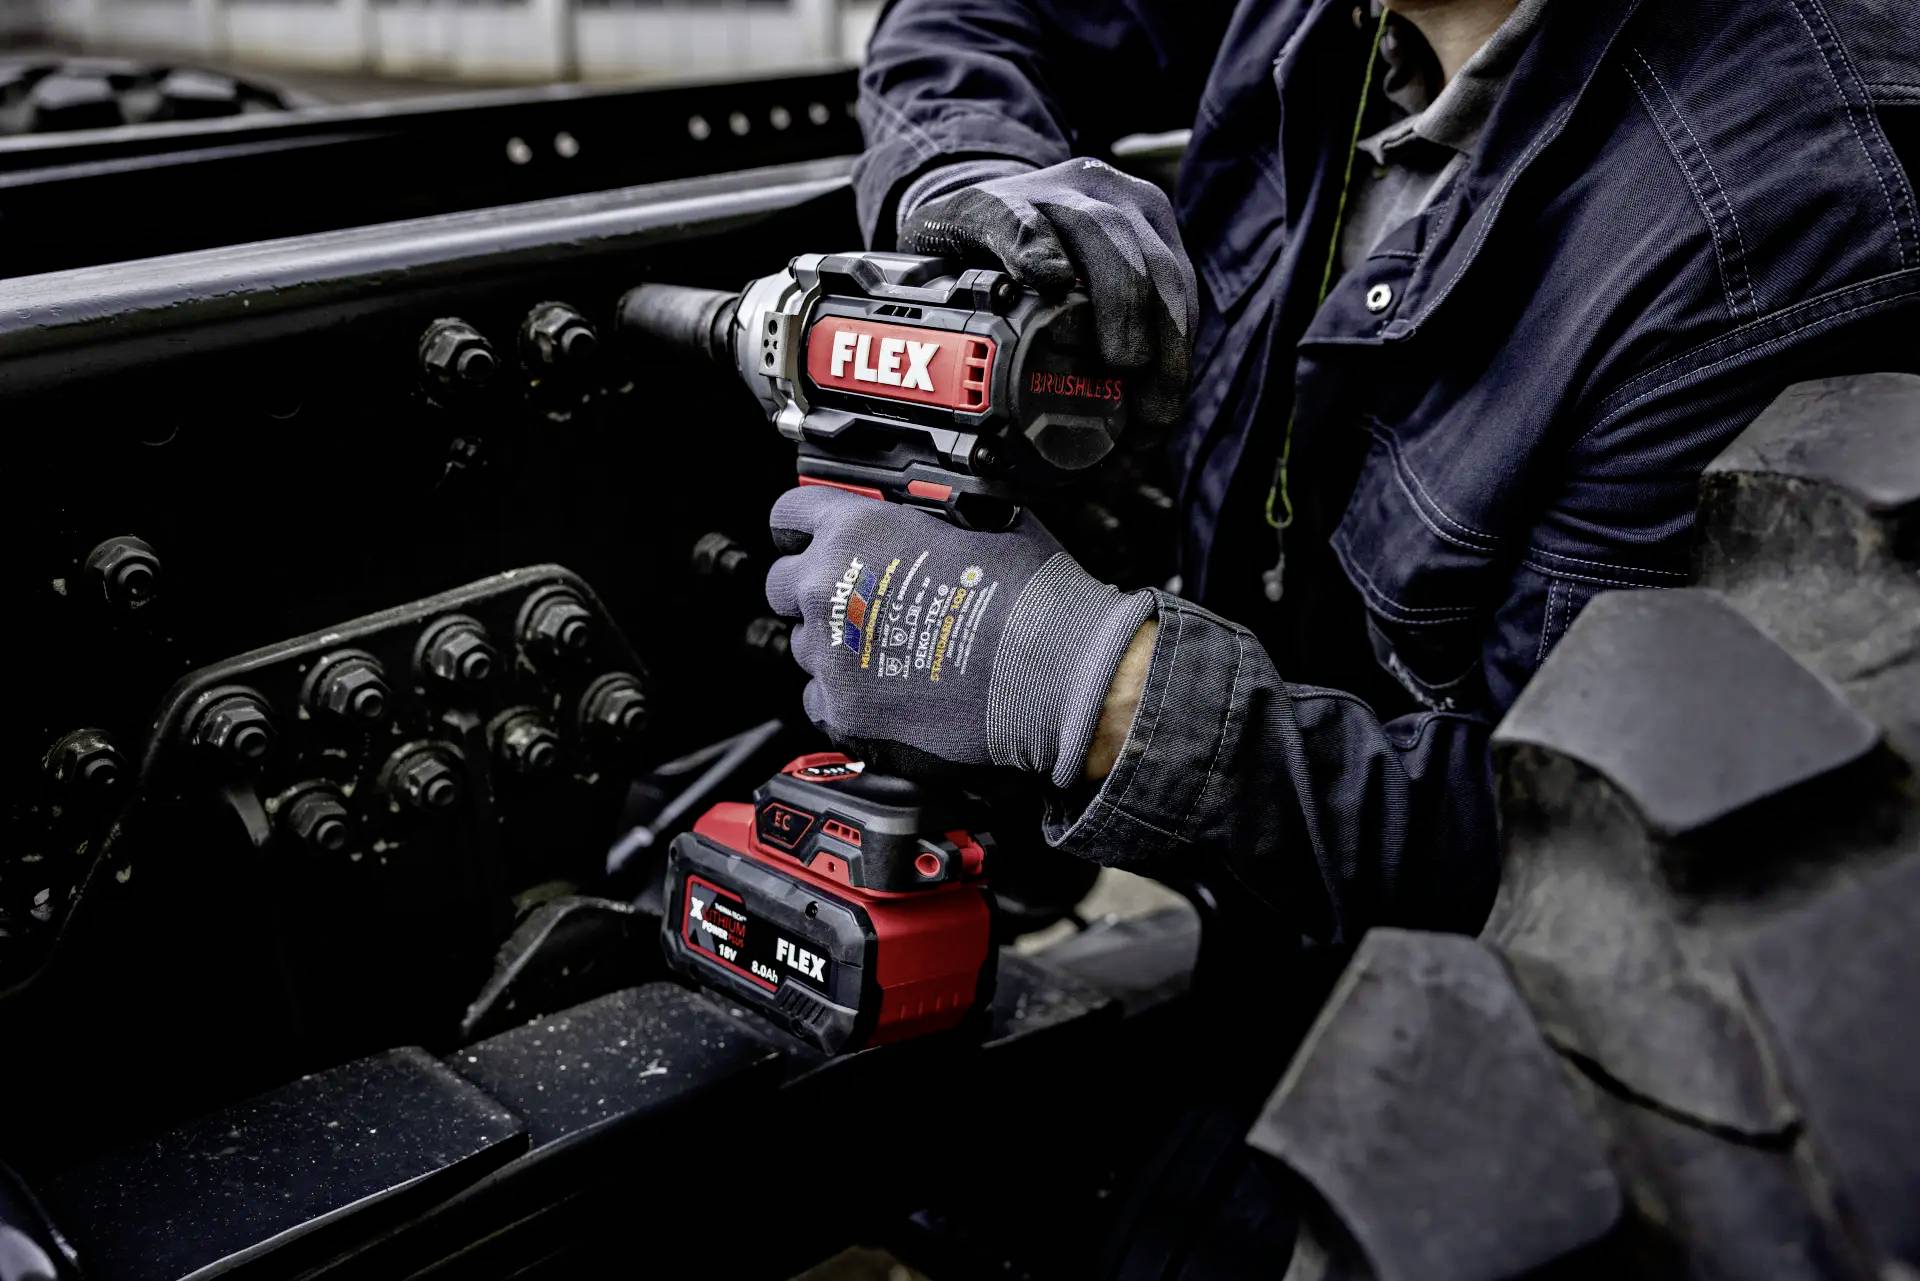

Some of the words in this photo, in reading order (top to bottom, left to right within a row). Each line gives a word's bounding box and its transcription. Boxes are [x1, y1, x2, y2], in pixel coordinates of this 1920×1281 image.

[830, 331, 940, 392] FLEX
[1030, 372, 1124, 401] BRUSHLESS
[829, 557, 863, 647] winkler
[930, 613, 954, 682] STANDARD
[951, 587, 967, 609] 100
[774, 810, 792, 831] EC
[702, 919, 728, 941] POWER
[703, 908, 747, 938] LITHIUM
[719, 943, 738, 962] 18V
[776, 937, 826, 983] FLEX
[751, 960, 778, 984] 8.0Ah
